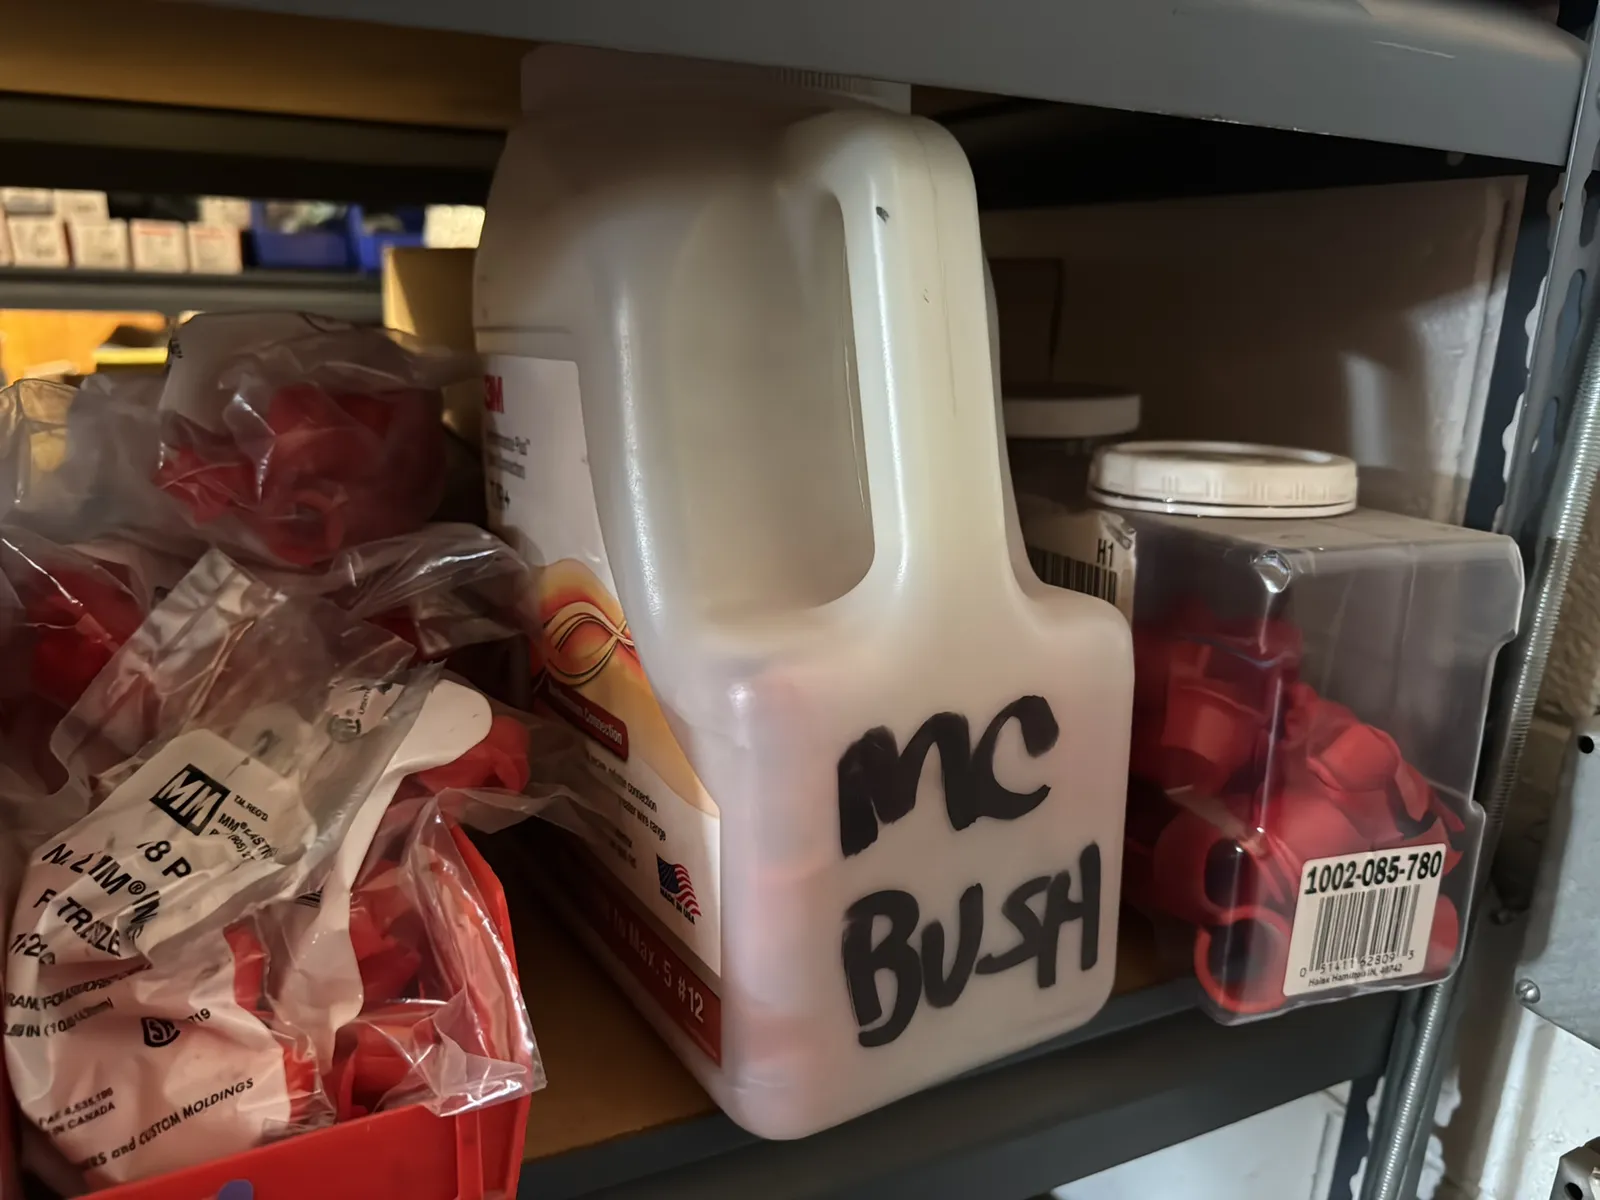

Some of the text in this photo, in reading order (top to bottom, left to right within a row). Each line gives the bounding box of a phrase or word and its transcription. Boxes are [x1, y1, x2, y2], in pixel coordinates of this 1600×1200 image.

[1304, 850, 1442, 895] 1002-085-780
[842, 841, 1101, 1048] BUSH
[111, 1135, 137, 1159] and
[139, 1112, 182, 1146] CUSTOM
[183, 1077, 255, 1120] MOLDINGS
